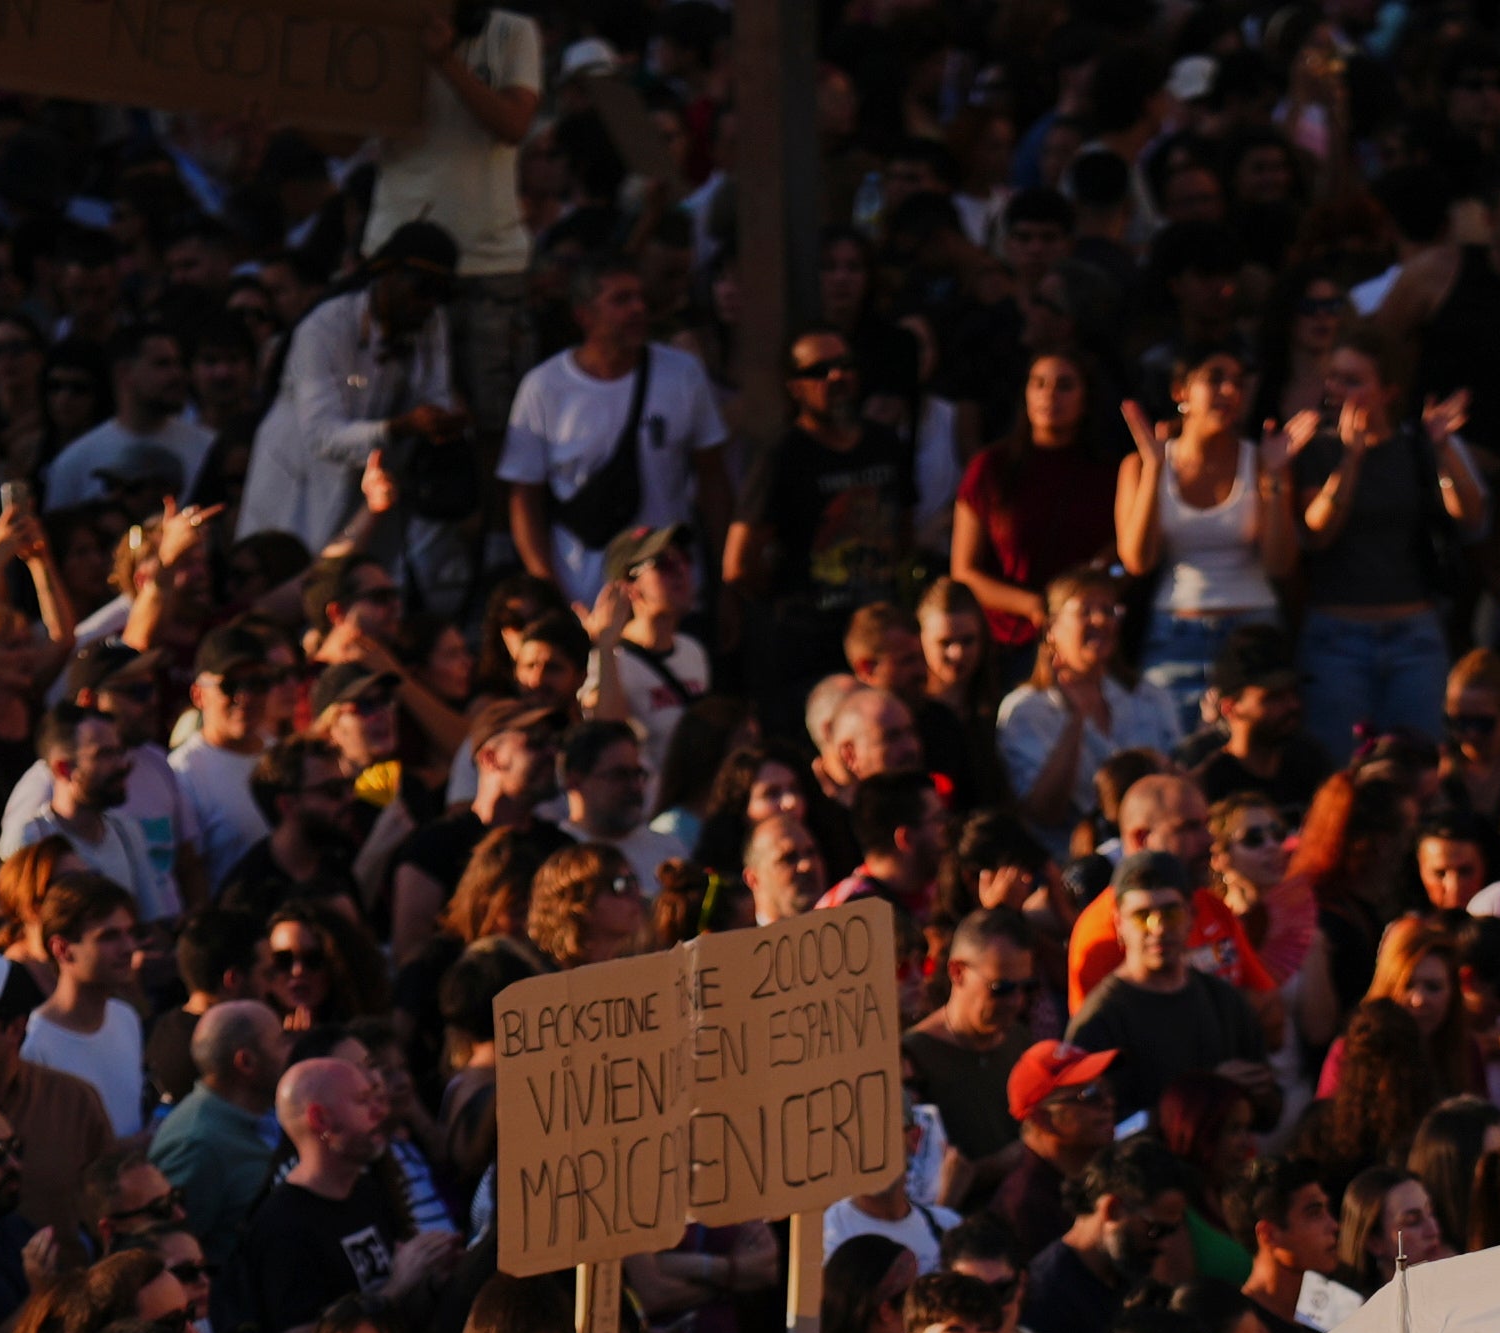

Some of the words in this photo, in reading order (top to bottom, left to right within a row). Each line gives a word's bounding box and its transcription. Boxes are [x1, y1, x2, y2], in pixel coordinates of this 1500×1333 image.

[106, 4, 389, 95] NEGOCIO
[500, 992, 659, 1057] BLACKSTONE
[751, 914, 872, 1000] 20.000
[770, 983, 887, 1067] ESPAÑA
[780, 1070, 889, 1187] CERO
